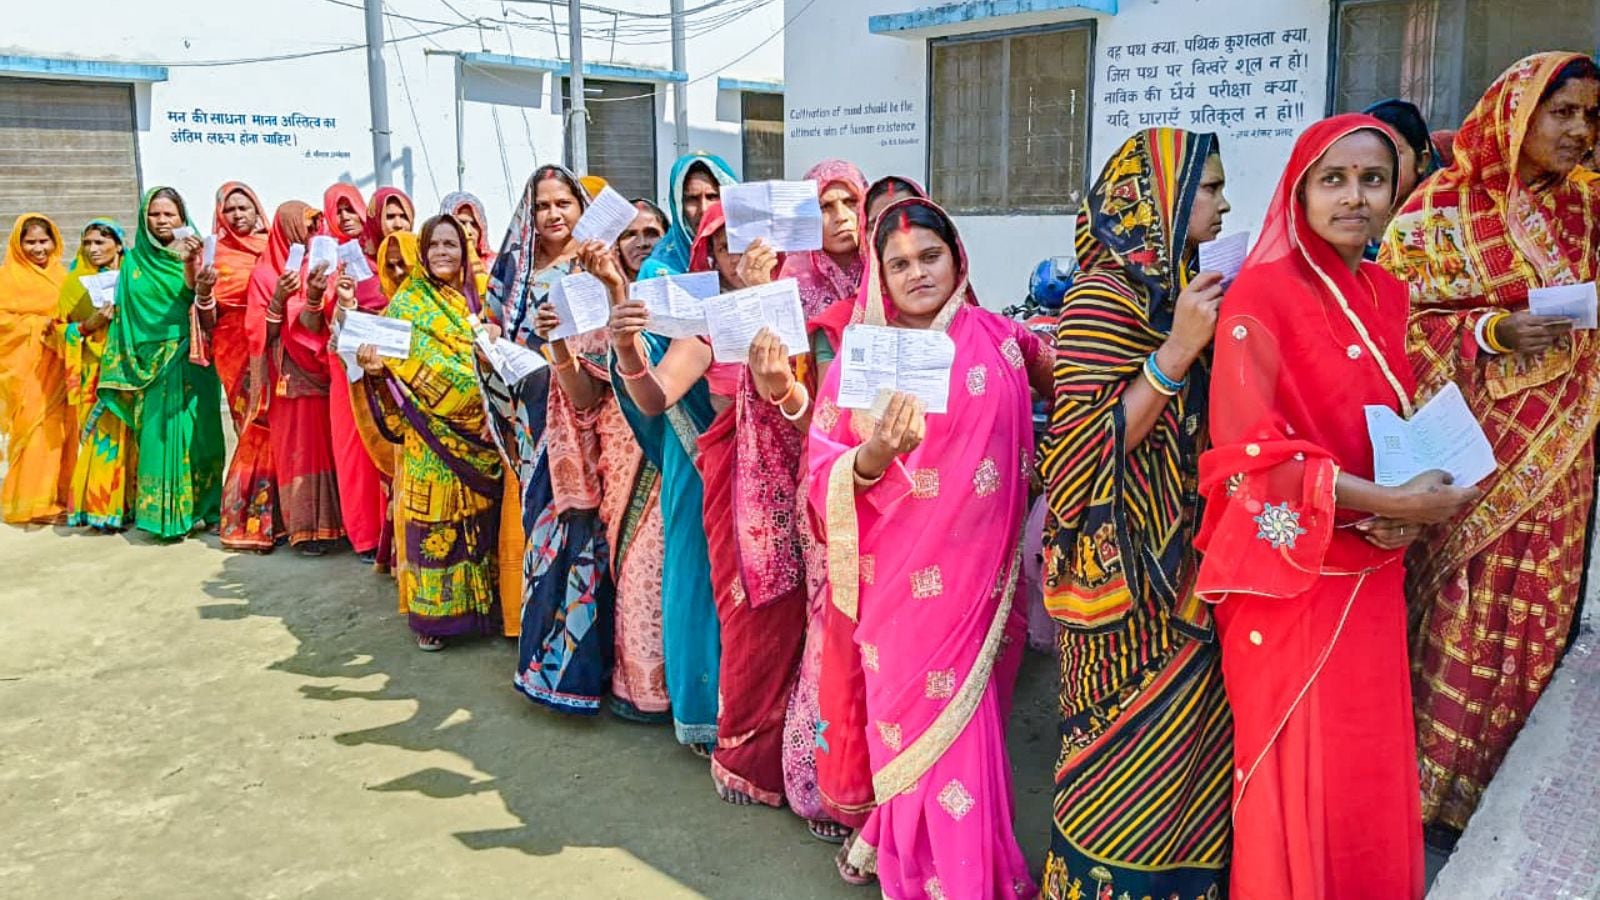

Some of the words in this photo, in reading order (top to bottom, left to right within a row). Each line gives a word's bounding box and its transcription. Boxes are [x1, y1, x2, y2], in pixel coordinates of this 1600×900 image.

[1107, 46, 1121, 61] वह
[1127, 45, 1146, 57] पथ
[1184, 35, 1219, 52] पथिक
[1224, 31, 1274, 54] कुशलता
[1107, 64, 1130, 82] जिस
[1137, 66, 1157, 79] पथ
[1166, 64, 1184, 78] पर
[1192, 56, 1228, 76] बिखरे
[1235, 56, 1262, 77] शूल
[1269, 55, 1283, 68] न
[1104, 87, 1138, 104] नाविक
[1144, 86, 1161, 102] की
[1209, 79, 1252, 100] परीक्षा
[168, 111, 186, 123] मन
[192, 108, 207, 125] की
[210, 113, 246, 126] साधना
[252, 114, 277, 127] मानव
[281, 113, 321, 129] अस्तित्व
[324, 117, 336, 129] का
[789, 106, 831, 120] Cultivation
[832, 105, 841, 117] of
[863, 101, 888, 114] should
[889, 101, 899, 113] be
[900, 99, 913, 112] the
[1106, 110, 1129, 128] यदि
[1190, 105, 1244, 129] प्रतिकूल
[1255, 106, 1268, 119] न
[171, 128, 202, 144] अंतिम
[206, 132, 236, 146] लक्ष्य
[239, 130, 258, 146] होना
[790, 127, 821, 138] ultimate
[840, 124, 848, 136] of
[850, 123, 875, 135] human
